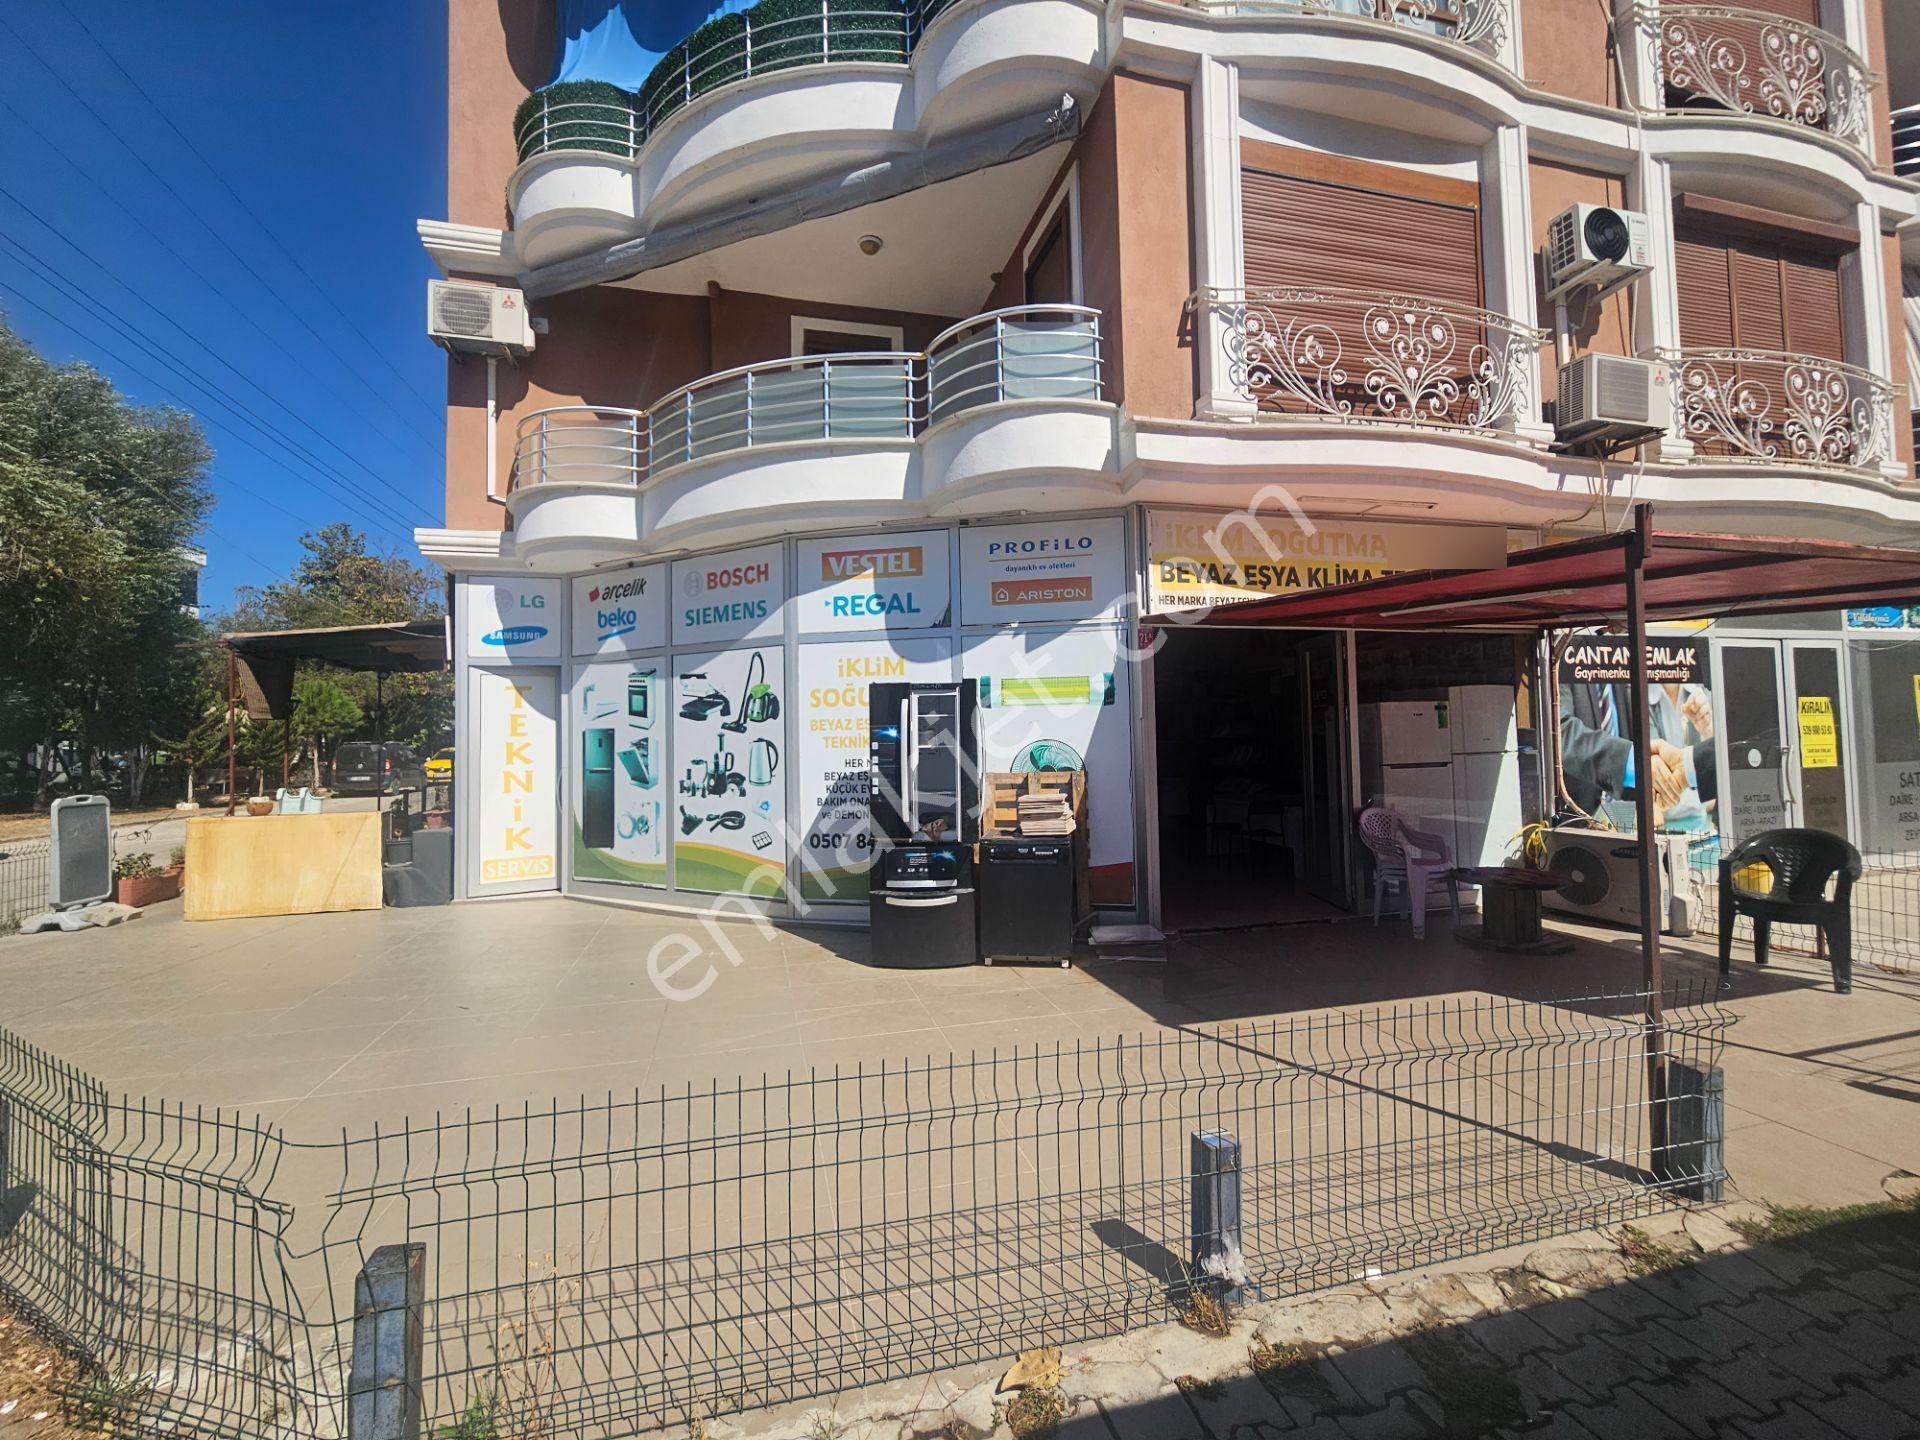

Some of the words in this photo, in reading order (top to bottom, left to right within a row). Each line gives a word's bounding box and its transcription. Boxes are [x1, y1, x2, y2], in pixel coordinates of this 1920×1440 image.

[828, 551, 917, 577] VESTEL
[706, 562, 770, 591] BOSCH
[1160, 560, 1238, 585] BEYAZ
[1244, 563, 1302, 590] EŞYA
[601, 578, 648, 602] arçelik
[1016, 588, 1087, 601] ARISTON
[520, 594, 545, 609] LG
[833, 592, 921, 617] REGAL
[1158, 595, 1176, 605] HER
[1177, 596, 1208, 606] MARKA
[597, 607, 637, 628] beko
[685, 600, 767, 627] SIEMENS
[489, 631, 542, 641] SAMSUNG
[1574, 667, 1630, 682] Gayrimenku
[1646, 667, 1690, 682] nışmanlığı
[810, 683, 870, 708] SOĞU
[810, 719, 854, 731] BEYAZ
[856, 718, 870, 732] EŞ
[845, 759, 863, 767] HER
[824, 771, 855, 781] BEYAZ
[857, 771, 869, 782] EŞ
[826, 783, 858, 795] KÜÇÜK
[817, 798, 847, 806] BAKIM
[849, 798, 870, 806] ONA
[834, 810, 869, 819] DEMON
[810, 833, 852, 849] 0507
